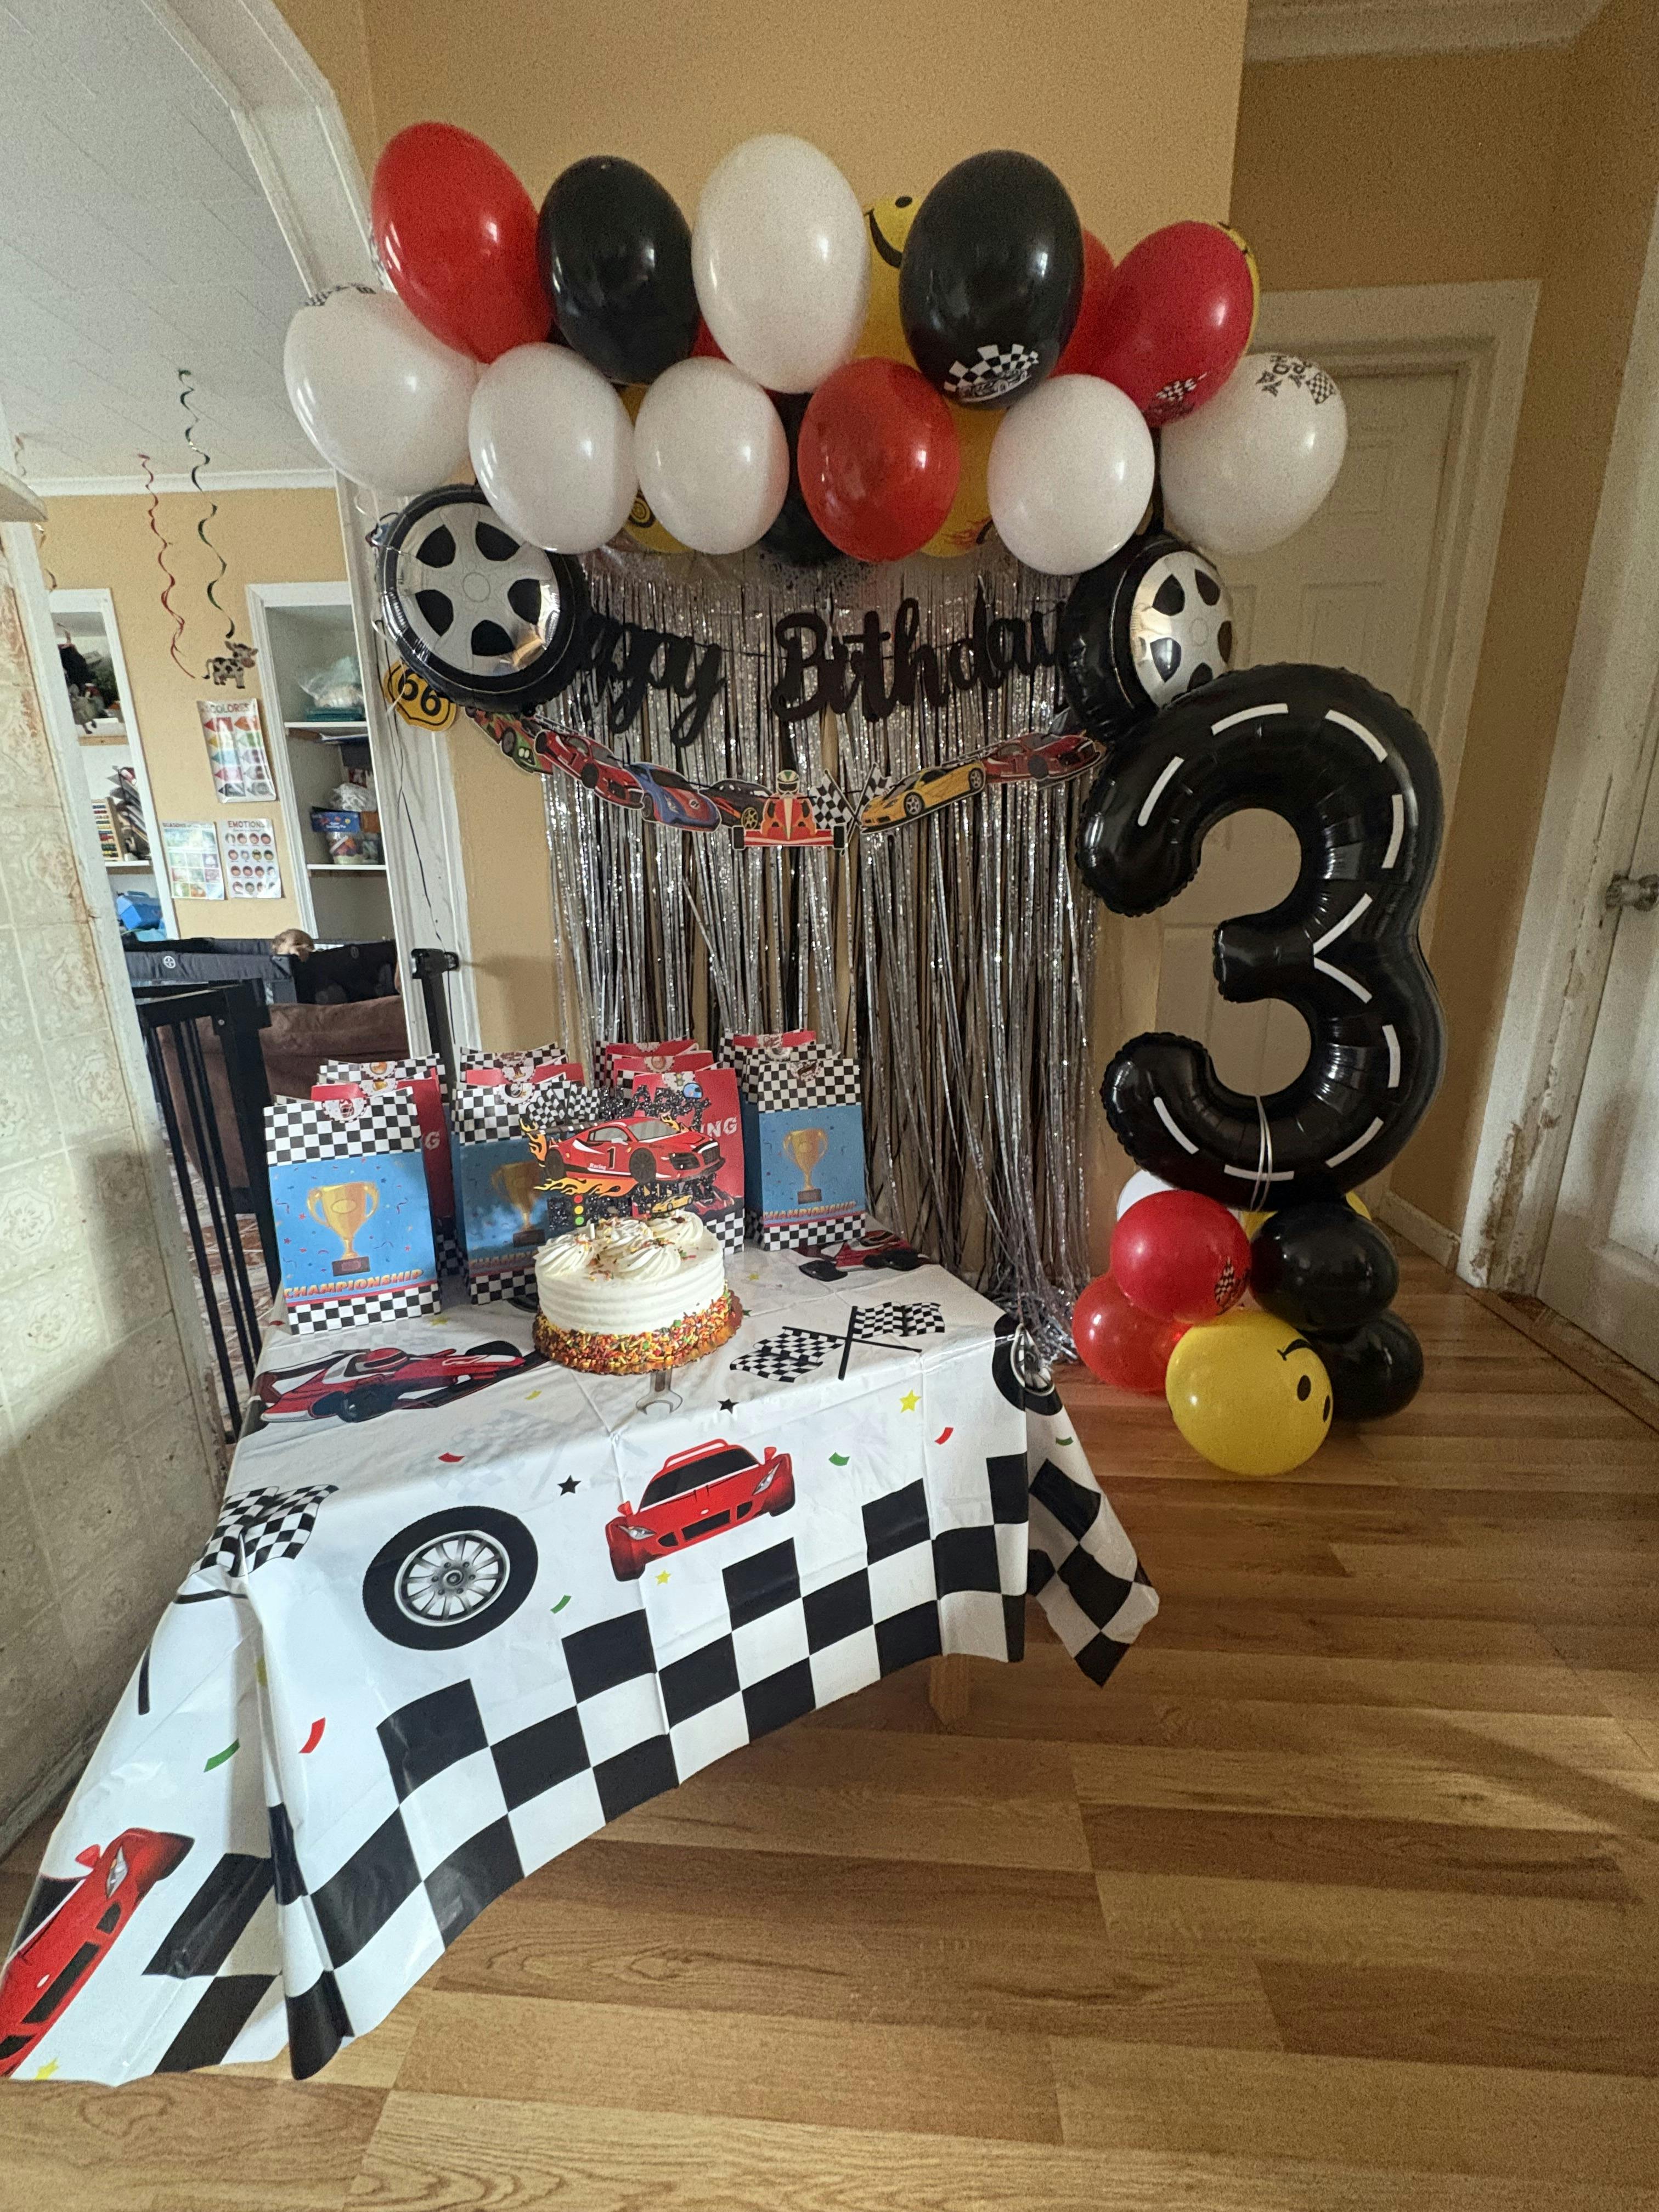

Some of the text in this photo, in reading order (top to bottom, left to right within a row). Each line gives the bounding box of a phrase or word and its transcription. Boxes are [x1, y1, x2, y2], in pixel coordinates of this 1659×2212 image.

[398, 668, 442, 717] 66
[607, 1146, 616, 1170] 1
[284, 1268, 424, 1299] CHAMPIONSHIP
